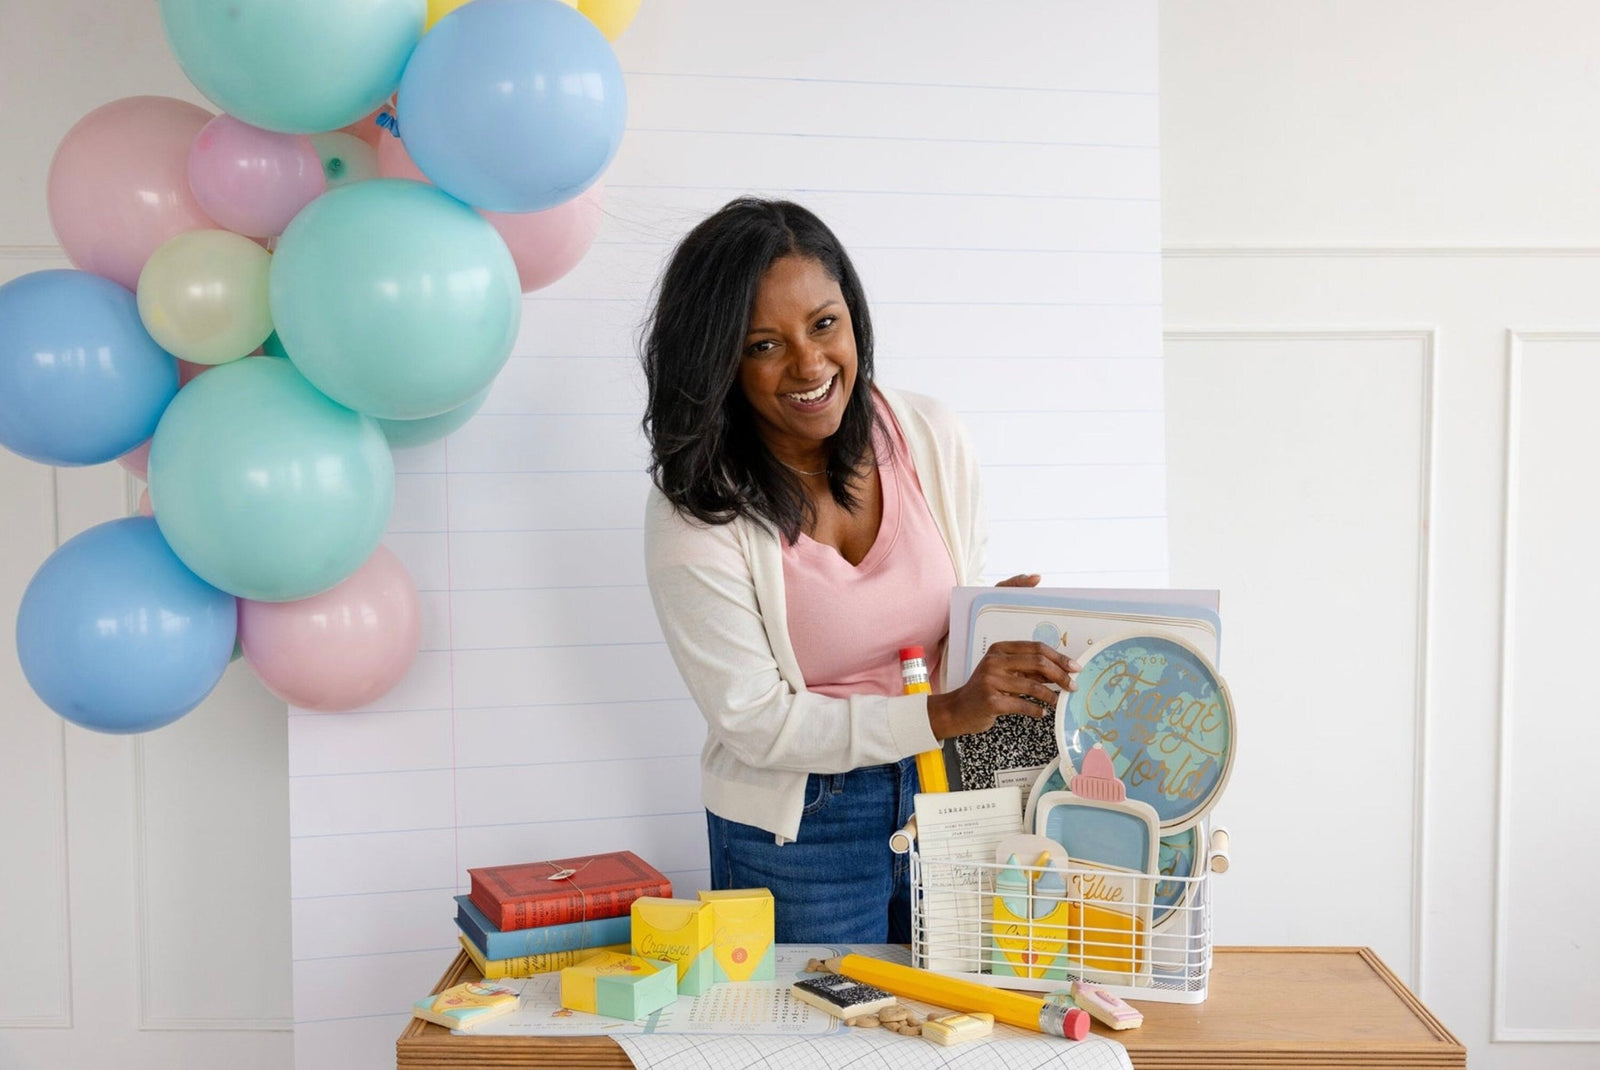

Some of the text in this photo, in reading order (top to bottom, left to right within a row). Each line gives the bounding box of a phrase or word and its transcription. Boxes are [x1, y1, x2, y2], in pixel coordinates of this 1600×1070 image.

[1140, 656, 1168, 666] YOU
[1086, 660, 1222, 756] Change
[938, 802, 996, 815] LIBRARY CARD
[1072, 872, 1125, 910] Glue
[641, 933, 690, 961] Crayons
